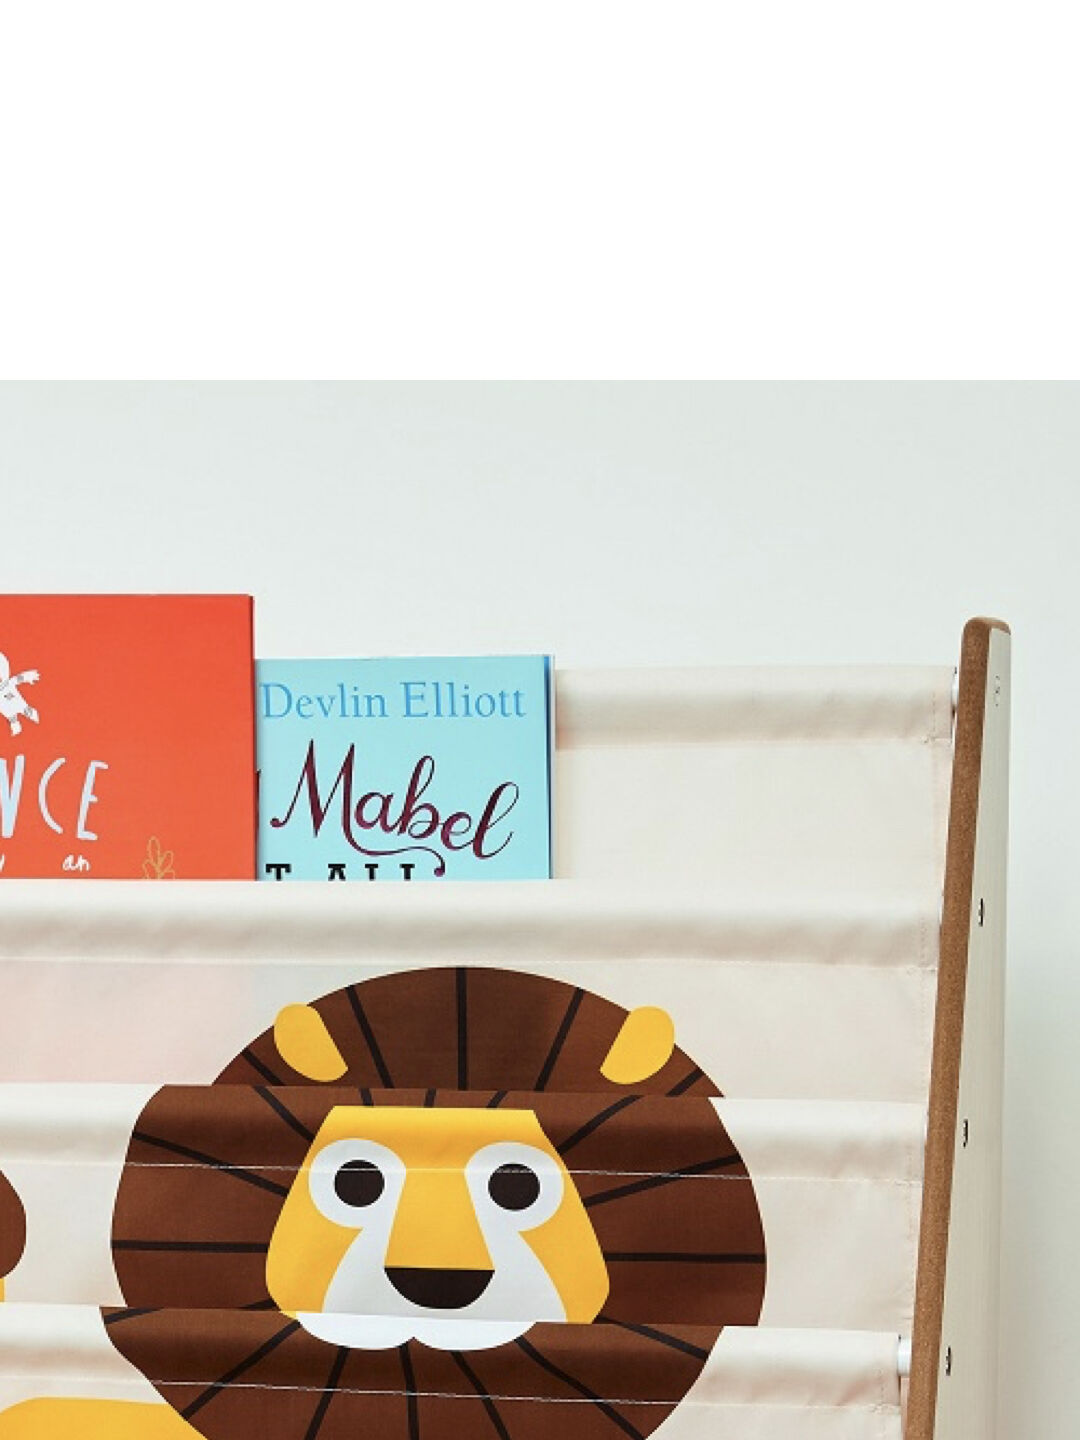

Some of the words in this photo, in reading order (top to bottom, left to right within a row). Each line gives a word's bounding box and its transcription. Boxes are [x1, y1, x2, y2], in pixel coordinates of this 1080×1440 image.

[260, 682, 389, 719] Devlin
[400, 681, 526, 718] Elliott
[270, 738, 519, 877] Mabel
